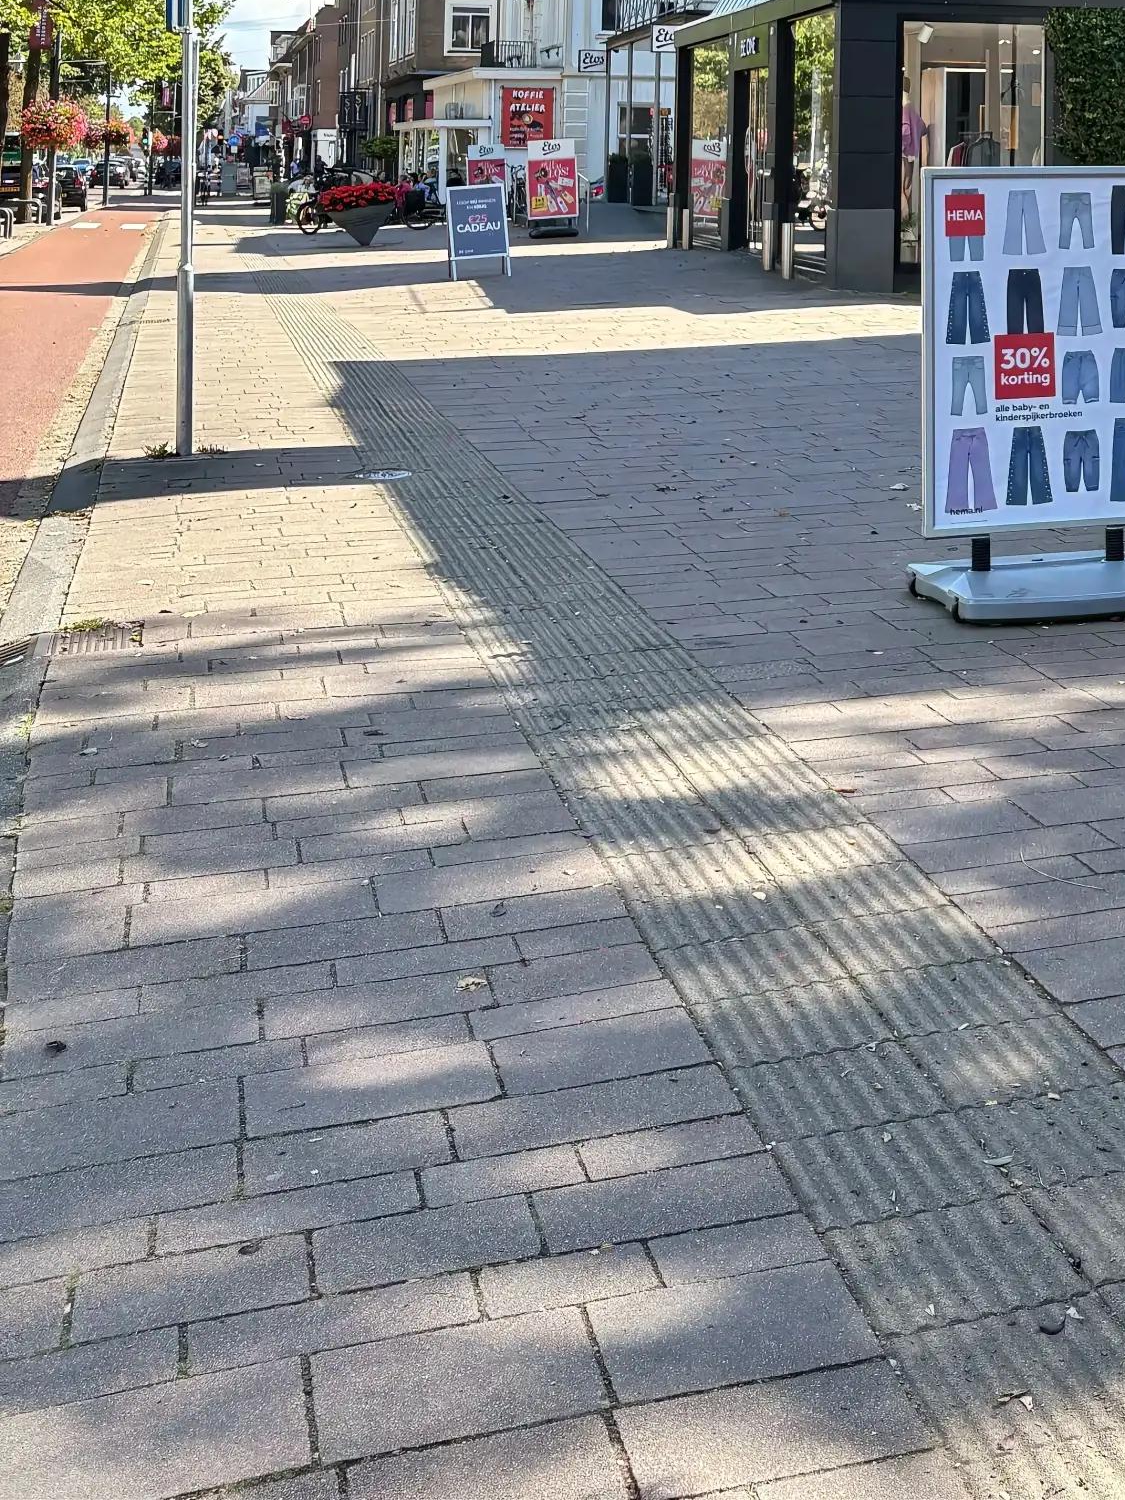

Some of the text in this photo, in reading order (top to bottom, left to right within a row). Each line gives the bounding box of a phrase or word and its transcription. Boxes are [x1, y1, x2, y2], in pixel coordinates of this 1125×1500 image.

[656, 28, 674, 48] Eto
[583, 52, 604, 69] Etos
[512, 90, 544, 99] KOFFIE
[510, 103, 546, 112] ATELIER
[479, 145, 494, 157] Etos
[542, 141, 561, 155] Etos
[468, 214, 487, 223] €25
[947, 210, 983, 222] HEMA
[456, 221, 501, 233] CADEAU
[1000, 347, 1050, 369] 30%
[1000, 372, 1050, 386] korting
[995, 404, 1010, 412] alle
[1012, 403, 1037, 412] baby-
[995, 410, 1083, 422] kinderspijkerbroeken
[950, 506, 983, 516] hema.nl
